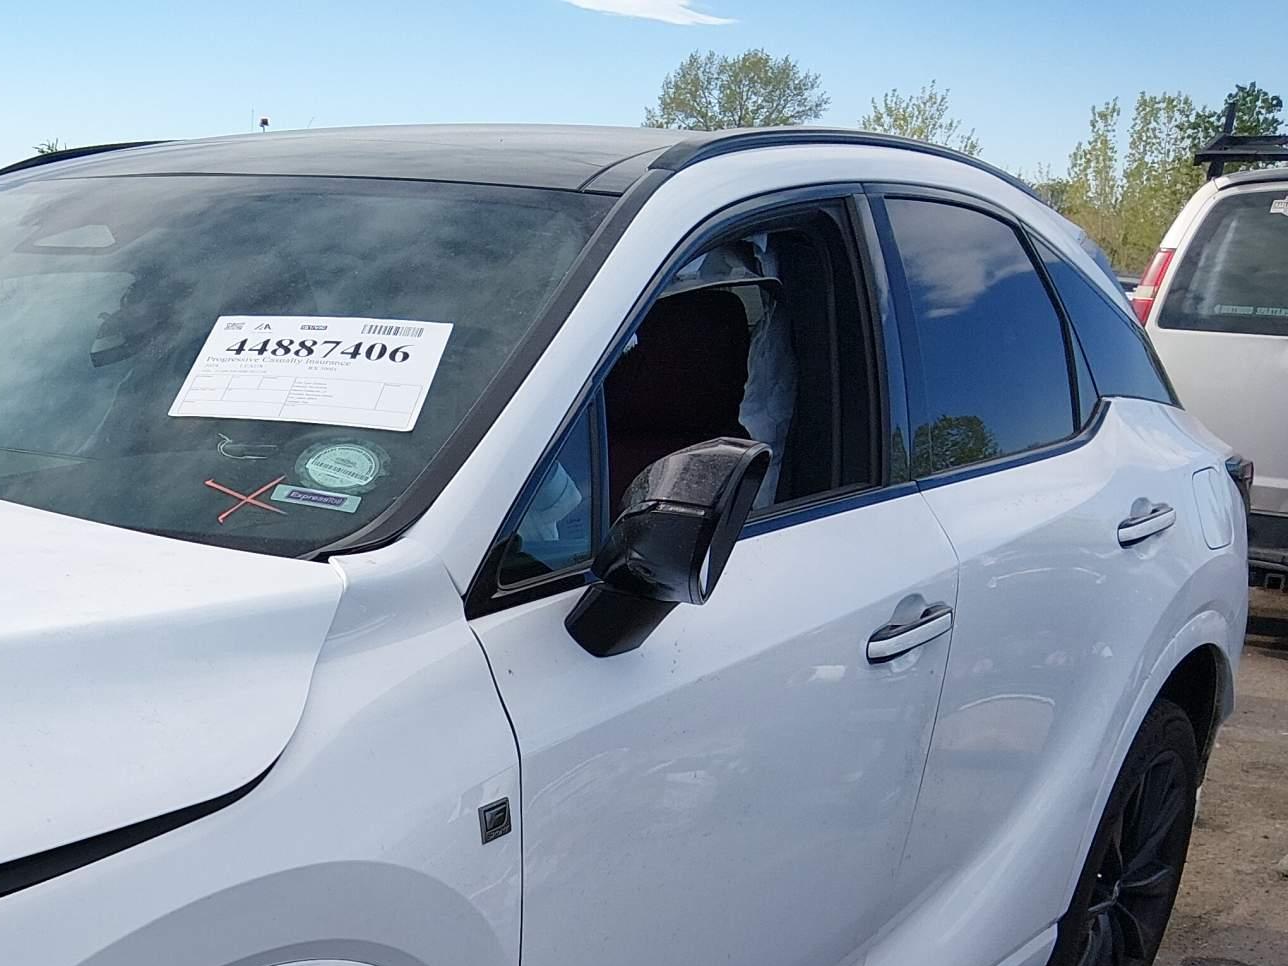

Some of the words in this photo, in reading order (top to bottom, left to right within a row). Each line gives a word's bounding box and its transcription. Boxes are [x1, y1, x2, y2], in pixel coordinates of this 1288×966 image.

[225, 338, 416, 363] 44887406
[206, 355, 260, 364] Progressive
[262, 356, 303, 365] Casualty
[305, 359, 352, 367] Insurance
